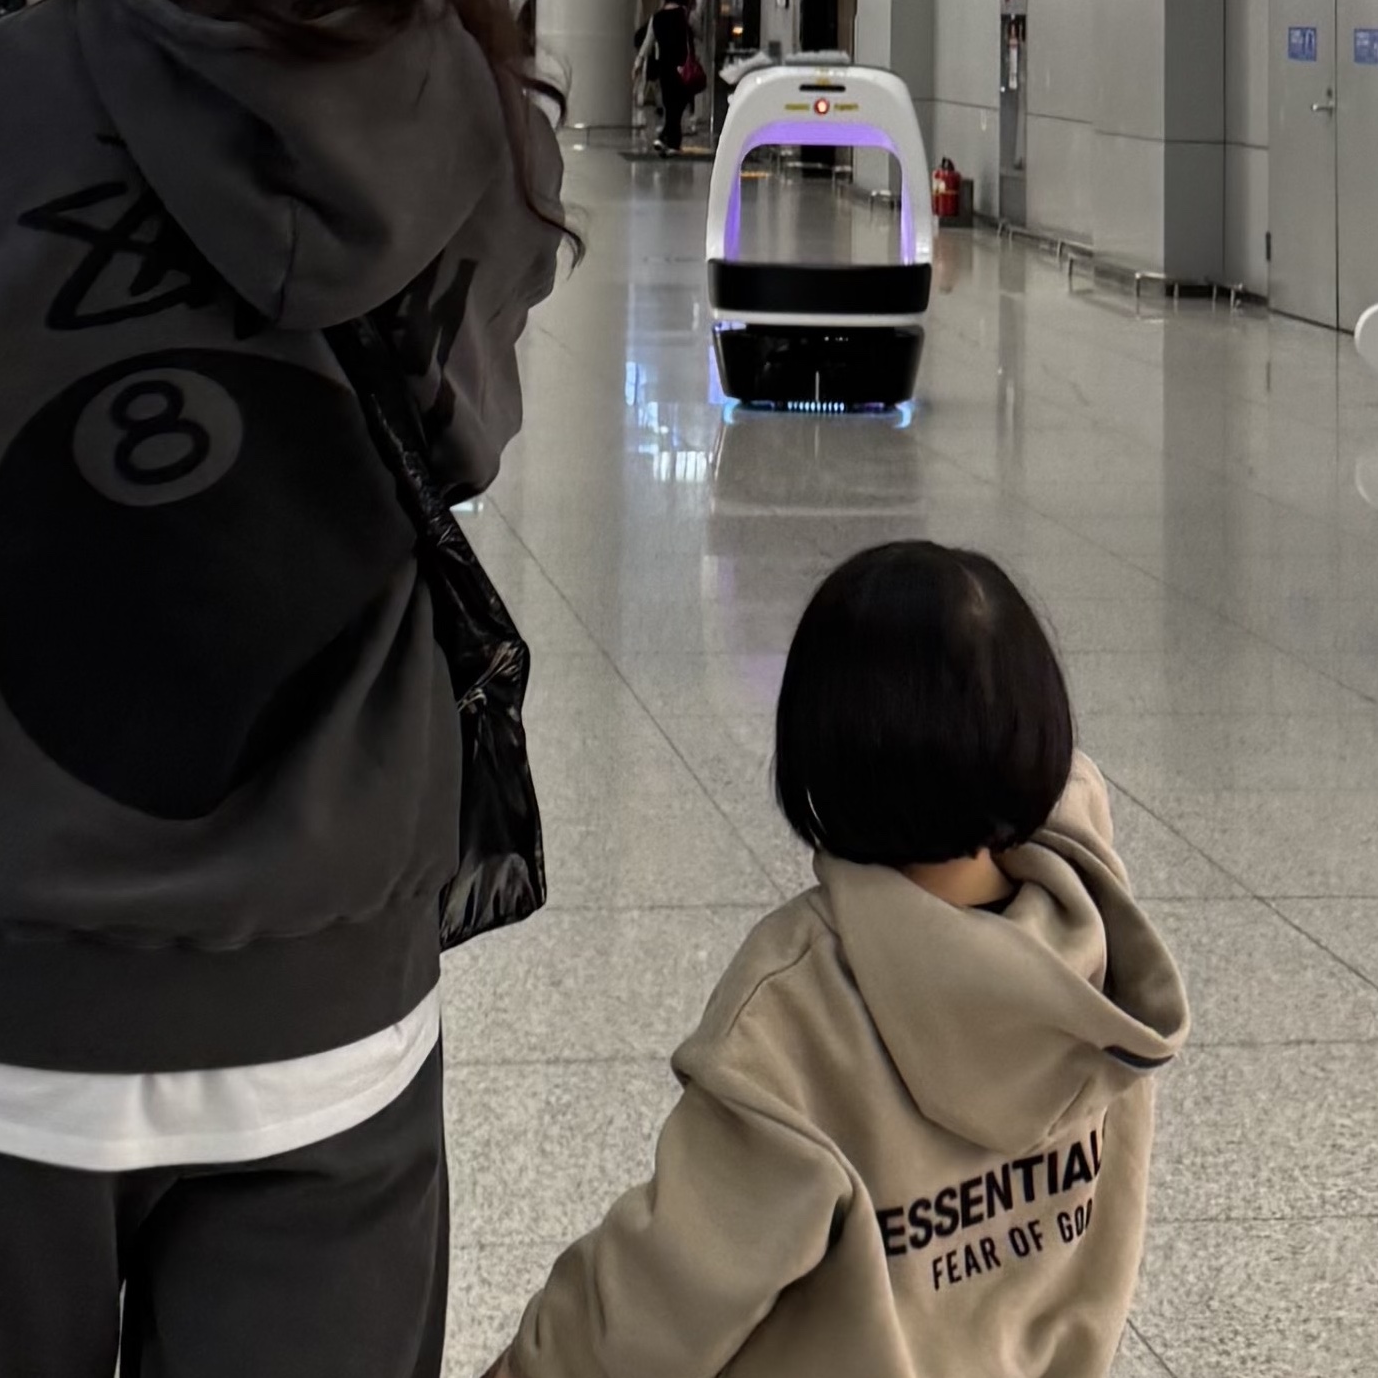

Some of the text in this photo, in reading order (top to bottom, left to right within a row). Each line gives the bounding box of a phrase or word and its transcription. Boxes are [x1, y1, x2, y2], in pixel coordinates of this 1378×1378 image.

[110, 379, 211, 486] 8
[932, 1237, 1001, 1291] FEAR
[1009, 1219, 1043, 1258] OF
